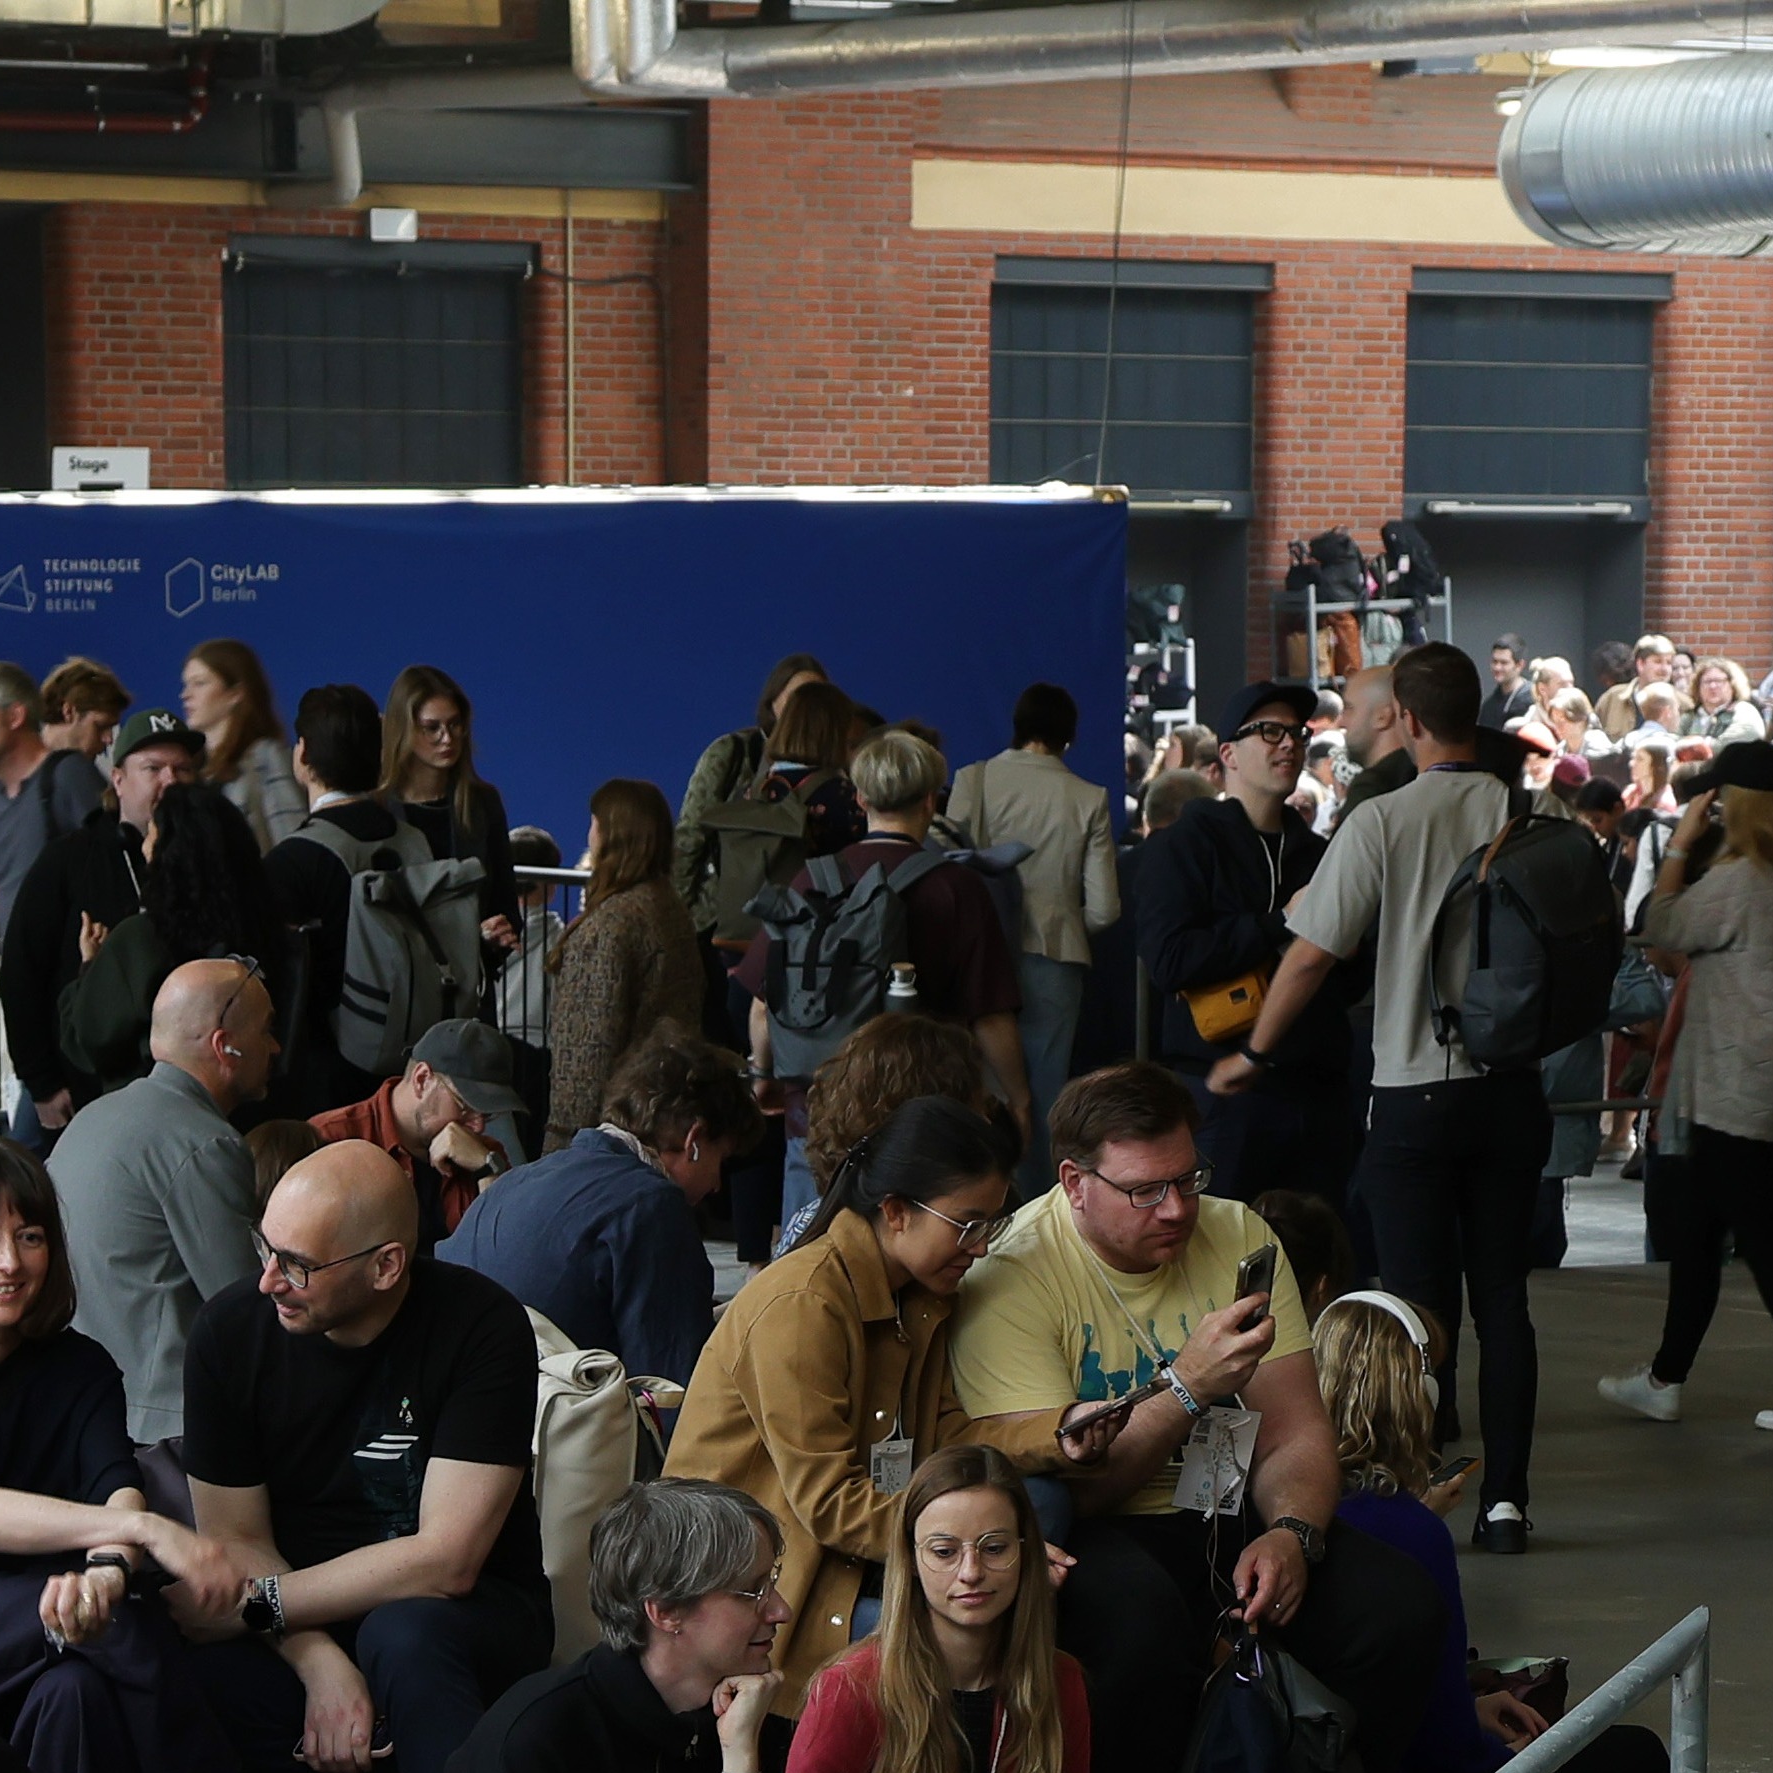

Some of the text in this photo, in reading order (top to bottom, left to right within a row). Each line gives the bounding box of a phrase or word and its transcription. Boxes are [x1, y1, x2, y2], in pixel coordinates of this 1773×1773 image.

[69, 456, 109, 473] Stage
[43, 558, 141, 573] TECHNOLOGIE
[211, 563, 280, 585] CityLAB
[44, 577, 114, 594] STIFTUNG
[212, 585, 257, 602] Berlin
[45, 597, 96, 612] BERLIN
